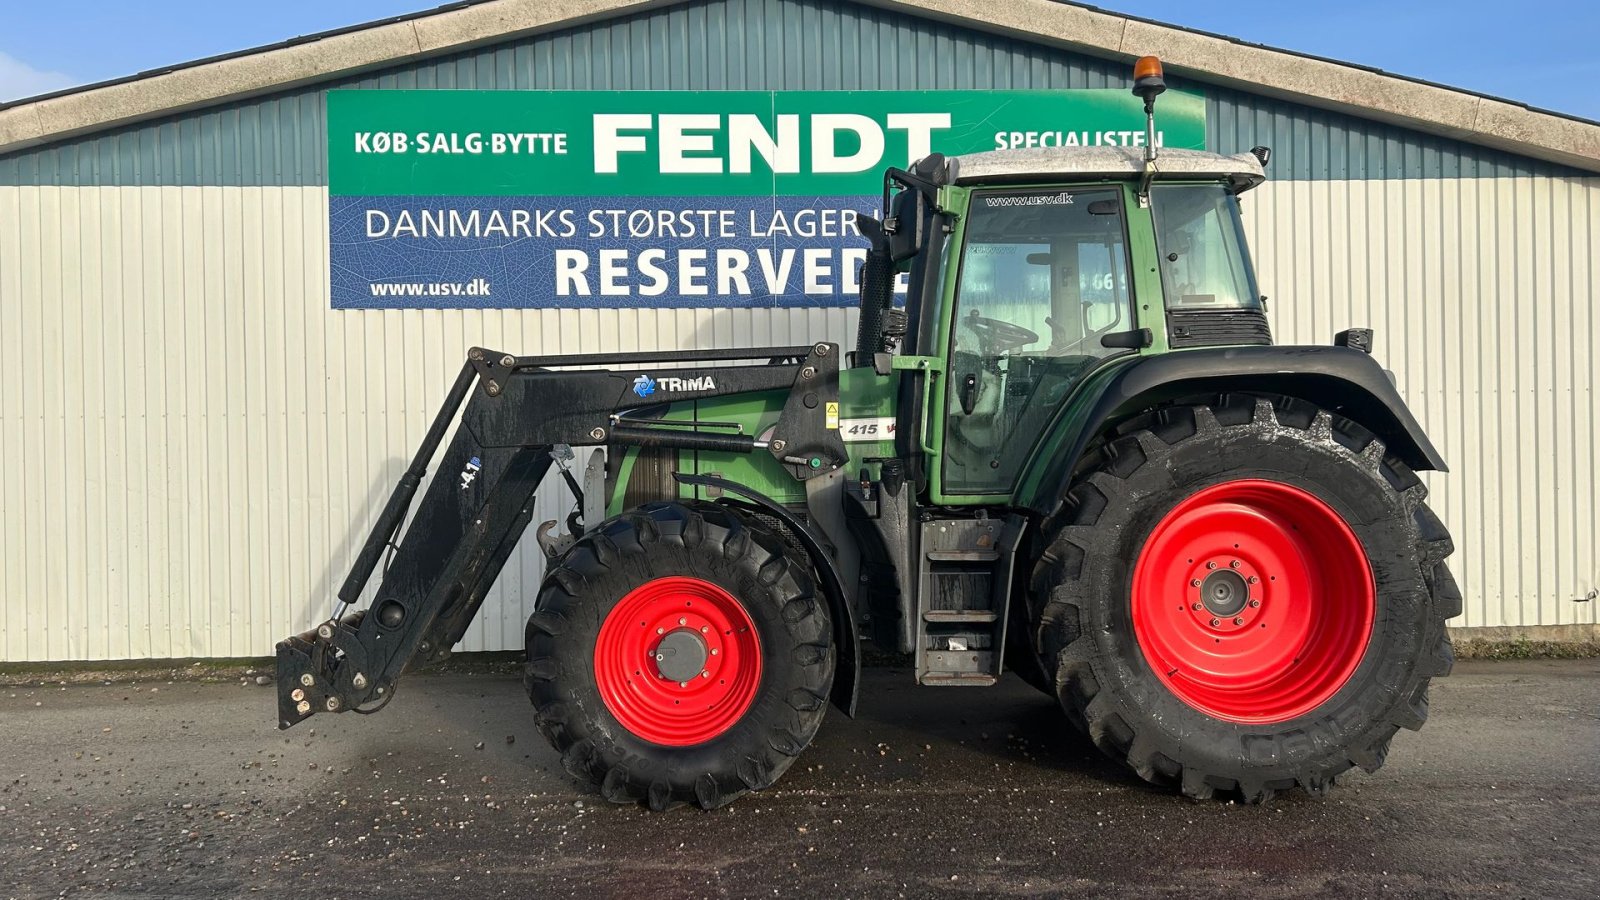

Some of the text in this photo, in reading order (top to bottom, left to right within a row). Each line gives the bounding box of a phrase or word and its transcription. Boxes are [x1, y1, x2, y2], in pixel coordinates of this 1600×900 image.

[593, 112, 951, 174] FENDT
[985, 192, 1074, 207] www.usv.dk
[366, 209, 576, 238] DANMARKS
[588, 208, 736, 238] STØRSTE
[750, 209, 861, 238] LAGER
[370, 278, 491, 296] www.usv.dk
[848, 424, 878, 435] 415
